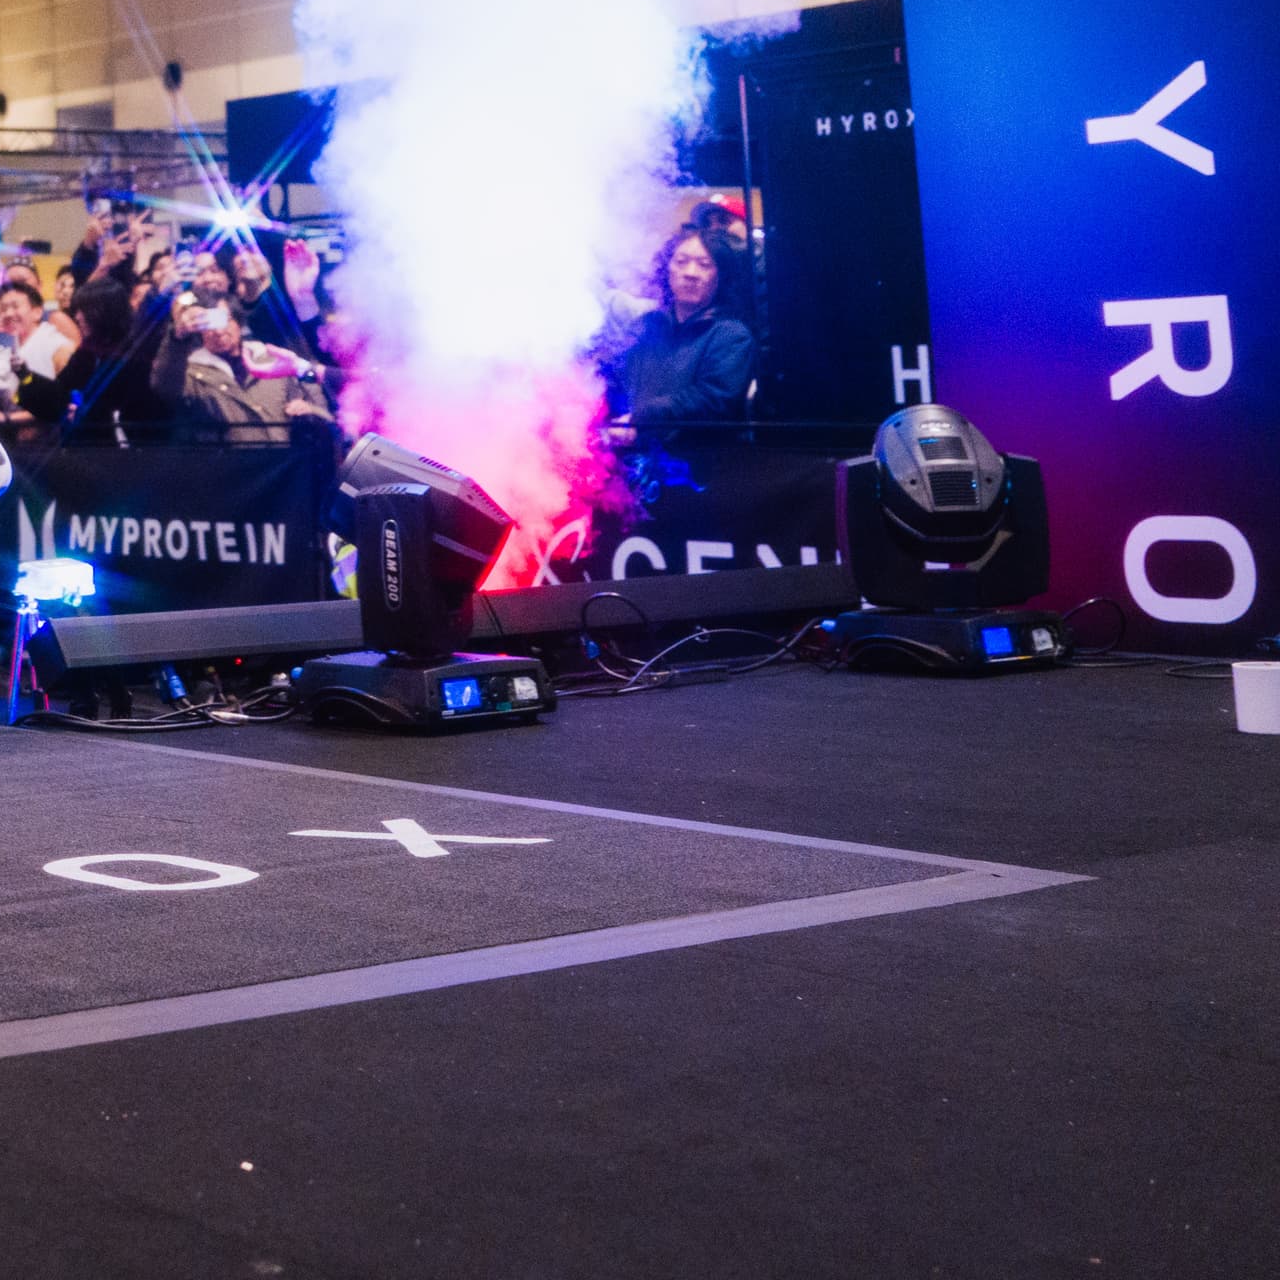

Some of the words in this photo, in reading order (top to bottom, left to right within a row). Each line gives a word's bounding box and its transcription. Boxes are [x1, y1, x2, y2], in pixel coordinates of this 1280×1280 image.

[68, 513, 286, 566] MYPROTEIN
[385, 529, 398, 572] BEAM
[387, 575, 400, 602] 200
